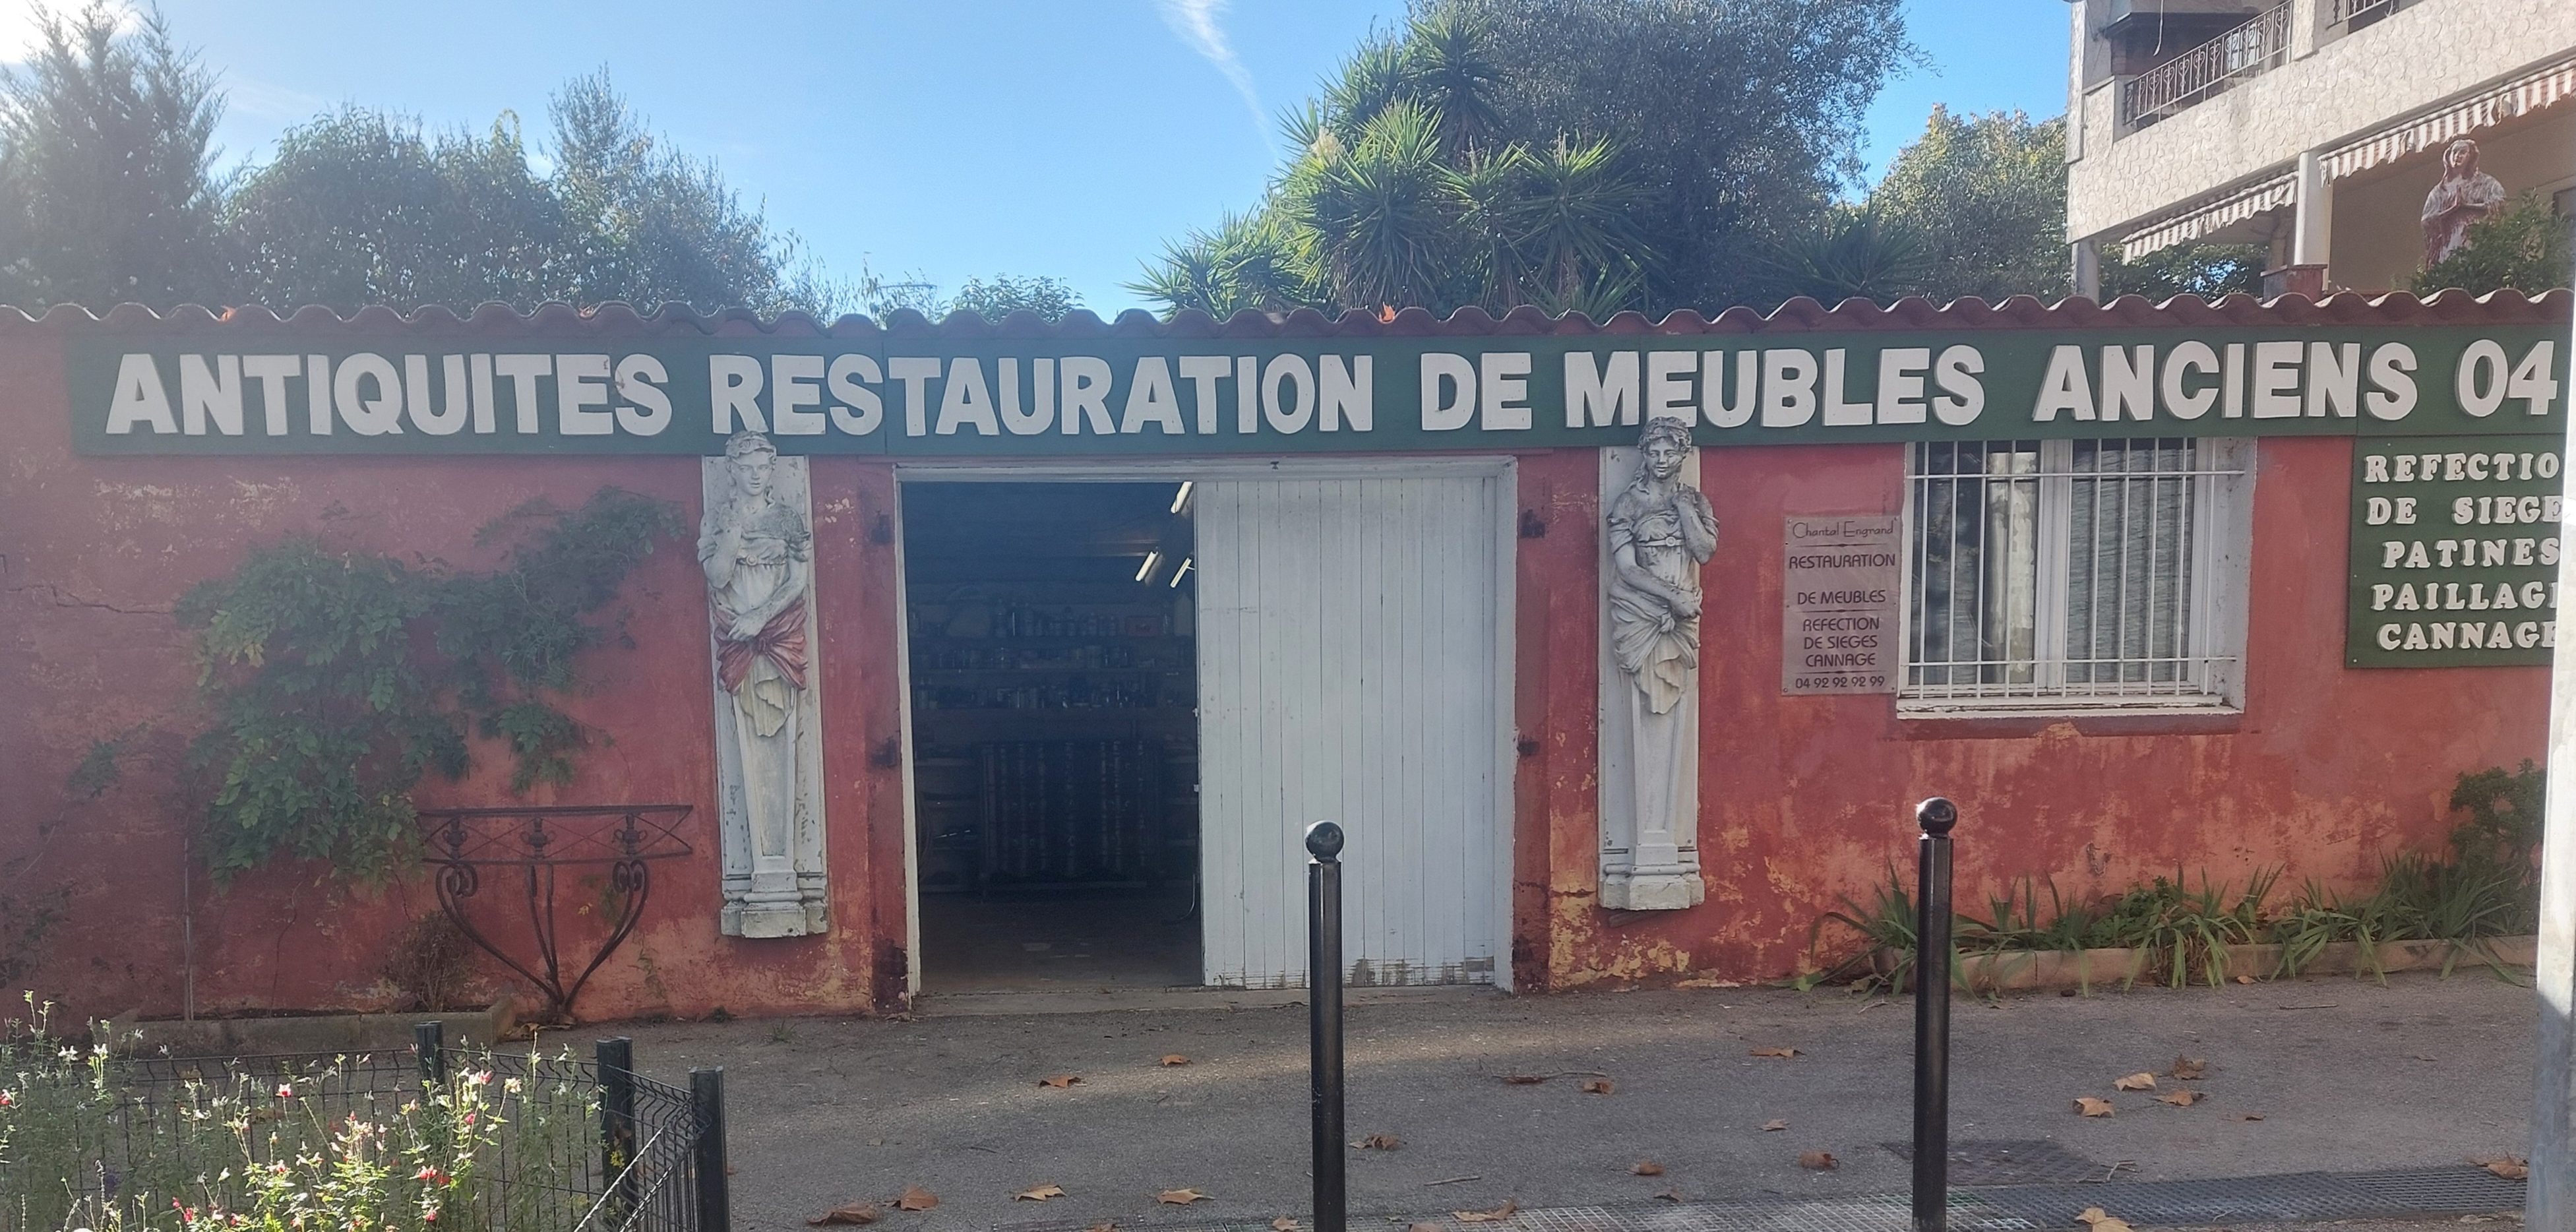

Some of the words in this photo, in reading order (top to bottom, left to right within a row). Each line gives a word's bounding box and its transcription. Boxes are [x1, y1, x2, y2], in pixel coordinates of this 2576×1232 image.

[106, 352, 672, 436] ANTIQUITES
[709, 353, 1374, 436] RESTAURATION
[1420, 352, 1533, 431] DE
[1564, 344, 1986, 429] MEUBLES
[2033, 340, 2418, 423] ANCIENS
[2455, 339, 2558, 417] 04
[2363, 452, 2565, 482] REFECTIO
[2365, 497, 2417, 525] DE
[1793, 522, 1839, 539] Chantal
[1843, 520, 1894, 538] Engrand
[1789, 553, 1896, 569] RESTAURATION
[2381, 537, 2560, 569] PATINES
[1797, 592, 1816, 605] DE
[1820, 590, 1886, 605] MEUBLES
[1802, 617, 1880, 632] REFECTION
[1804, 636, 1823, 650] DE
[1827, 634, 1878, 649] SIEGES
[1805, 653, 1876, 667] CANNAGE
[1795, 678, 1810, 689] 04
[1814, 677, 1829, 688] 92
[1832, 677, 1847, 688] 92
[1851, 676, 1866, 687] 92
[1870, 675, 1885, 687] 99
